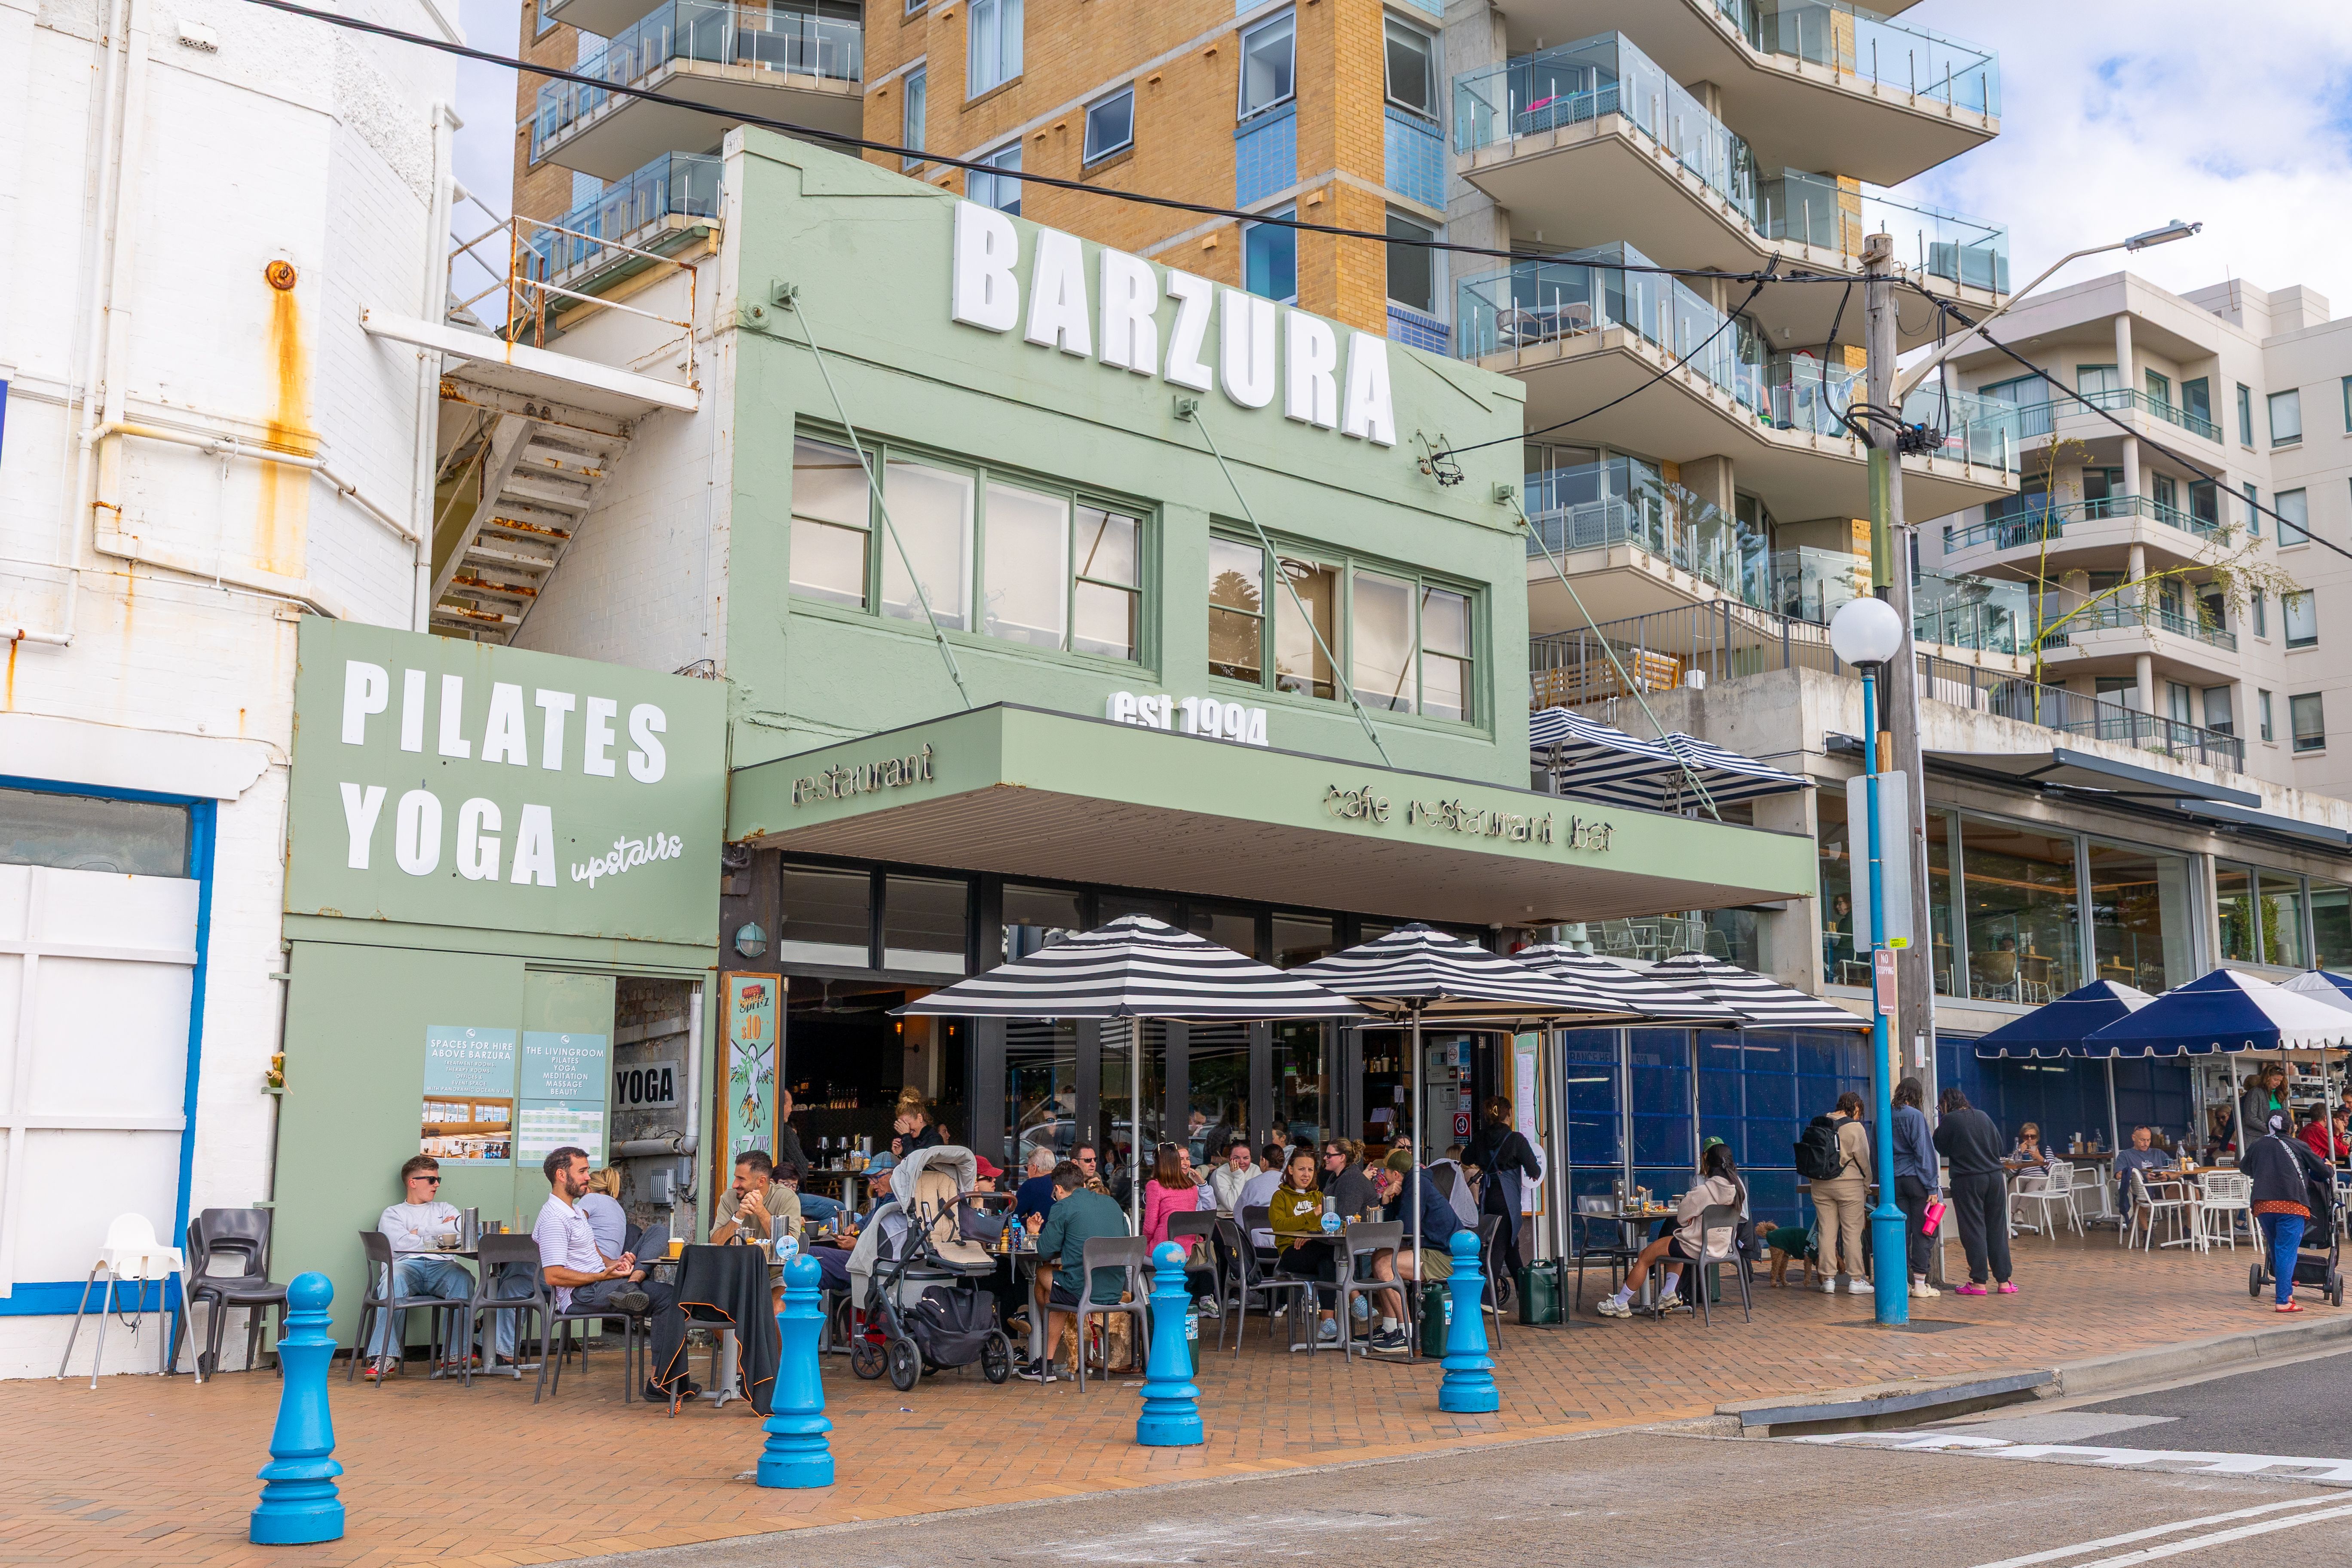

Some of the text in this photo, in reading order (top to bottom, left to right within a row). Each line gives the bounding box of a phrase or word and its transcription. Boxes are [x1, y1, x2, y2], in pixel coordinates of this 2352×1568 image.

[952, 200, 1396, 447] BARZURA
[342, 660, 667, 784] PILATES
[1106, 691, 1268, 747] est 1994
[791, 743, 934, 807] restaurant
[339, 782, 556, 887] YOGA
[1409, 799, 1555, 844] restaurant
[1569, 815, 1617, 851] bar
[571, 832, 683, 889] upstairs
[1877, 966, 1894, 975] STOPPING
[1880, 954, 1889, 964] NO
[743, 987, 759, 996] APEROL
[741, 1014, 761, 1040] $10
[431, 1039, 467, 1049] SPACES
[471, 1041, 489, 1050] FOR
[432, 1049, 511, 1060] ABOVE BARZURA
[527, 1047, 604, 1057] THE LIVINGROOM
[616, 1068, 674, 1104] YOGA
[756, 1135, 769, 1151] WINE
